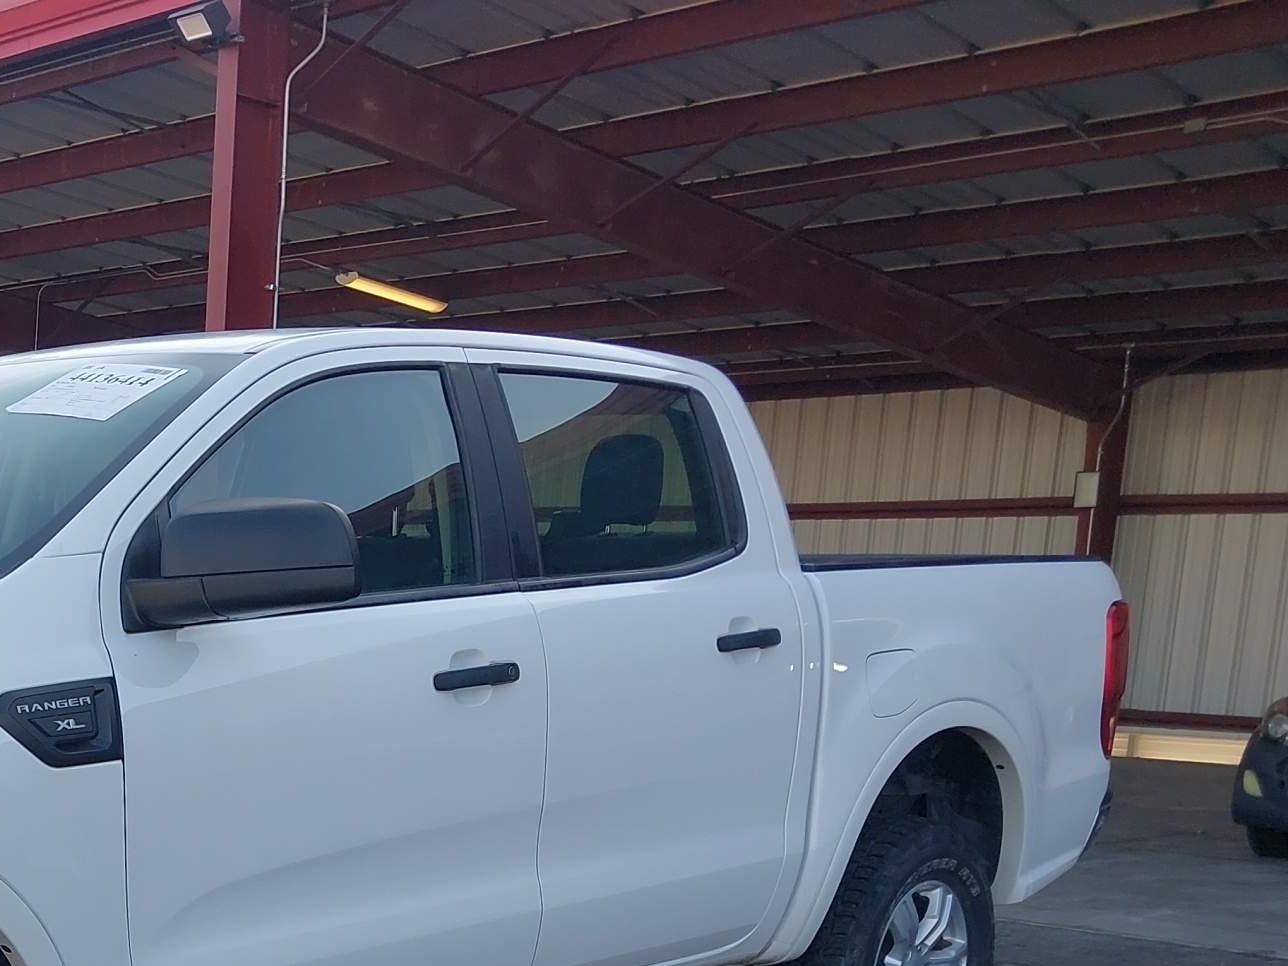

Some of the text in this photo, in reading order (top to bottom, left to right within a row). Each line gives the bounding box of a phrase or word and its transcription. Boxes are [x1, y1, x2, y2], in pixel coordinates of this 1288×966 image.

[69, 372, 156, 387] 44136414
[16, 696, 92, 714] RANGER
[52, 718, 86, 732] XL
